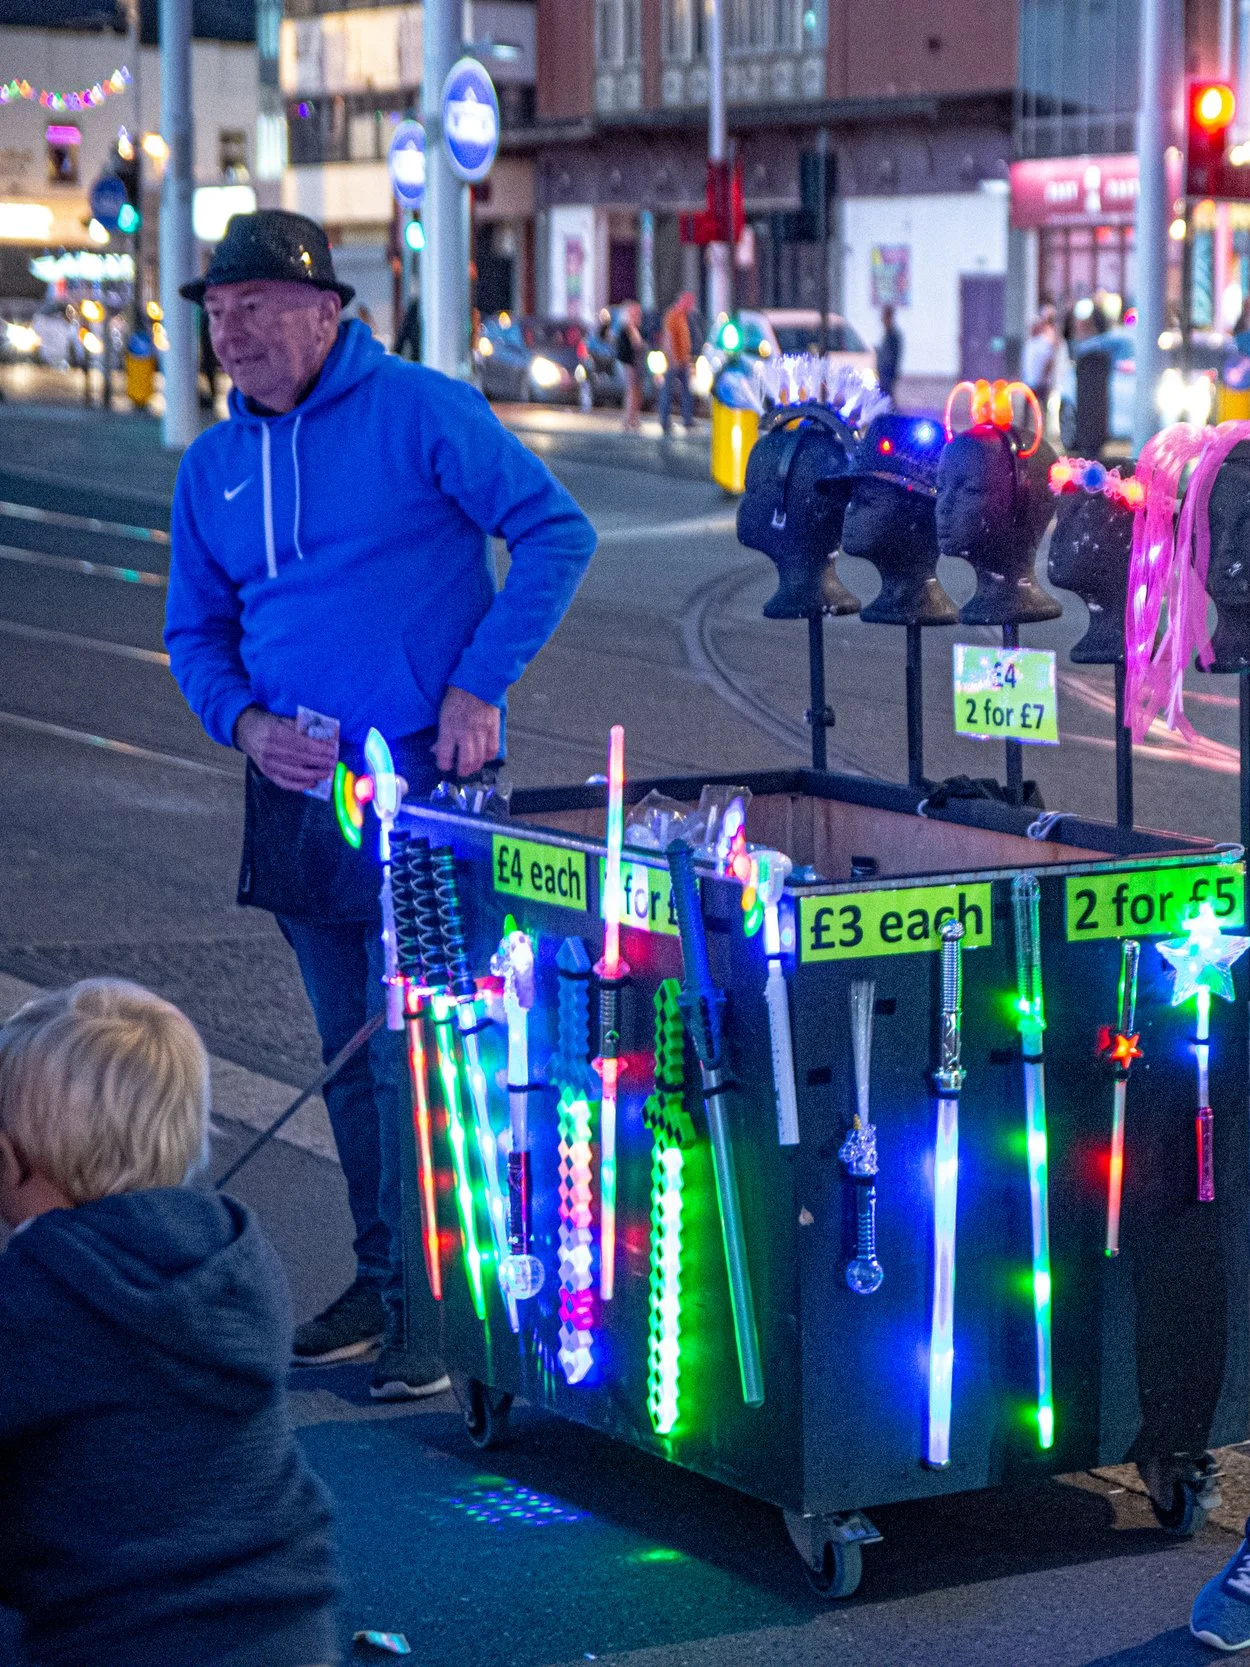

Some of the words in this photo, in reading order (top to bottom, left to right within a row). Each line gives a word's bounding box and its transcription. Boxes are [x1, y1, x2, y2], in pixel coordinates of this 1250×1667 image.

[992, 661, 1017, 688] £4
[965, 698, 978, 724] 2
[983, 698, 1014, 727] for
[1020, 702, 1045, 730] £7
[497, 844, 523, 887] £4
[530, 856, 581, 901] each
[623, 872, 661, 921] for
[810, 904, 864, 951] £3
[879, 892, 984, 944] each
[1075, 888, 1099, 931] 2
[1112, 882, 1174, 927] for
